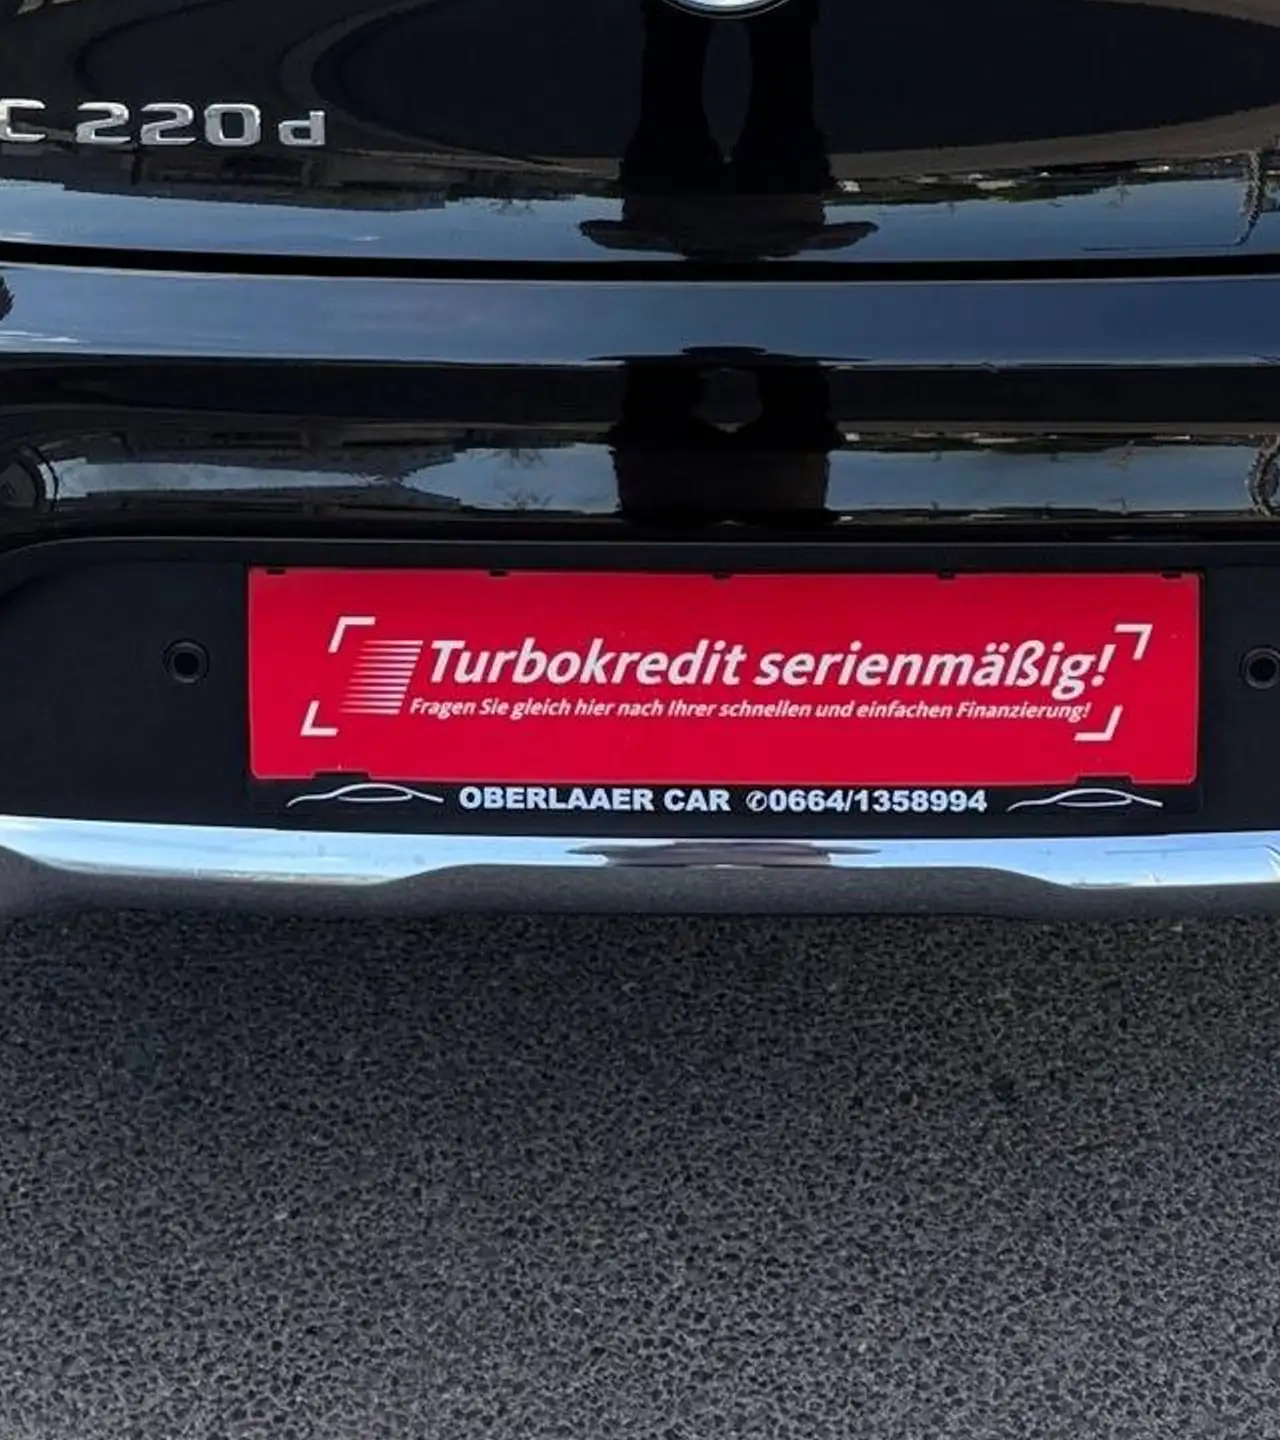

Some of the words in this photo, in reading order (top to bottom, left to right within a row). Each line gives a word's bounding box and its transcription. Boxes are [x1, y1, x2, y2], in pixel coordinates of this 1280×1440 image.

[430, 637, 747, 685] Turbokredit
[754, 639, 1116, 701] serienmäßig!
[410, 698, 476, 719] Fragen
[479, 698, 509, 715] Sie
[511, 698, 571, 720] gleich
[574, 698, 615, 716] hier
[618, 699, 664, 717] nach
[668, 699, 717, 717] Ihrer
[718, 700, 812, 717] schnellen
[815, 701, 855, 718] und
[856, 700, 953, 718] einfachen
[956, 700, 1092, 723] Finanzierung!
[458, 786, 655, 811] OBERLAAER
[663, 788, 731, 812] CAR
